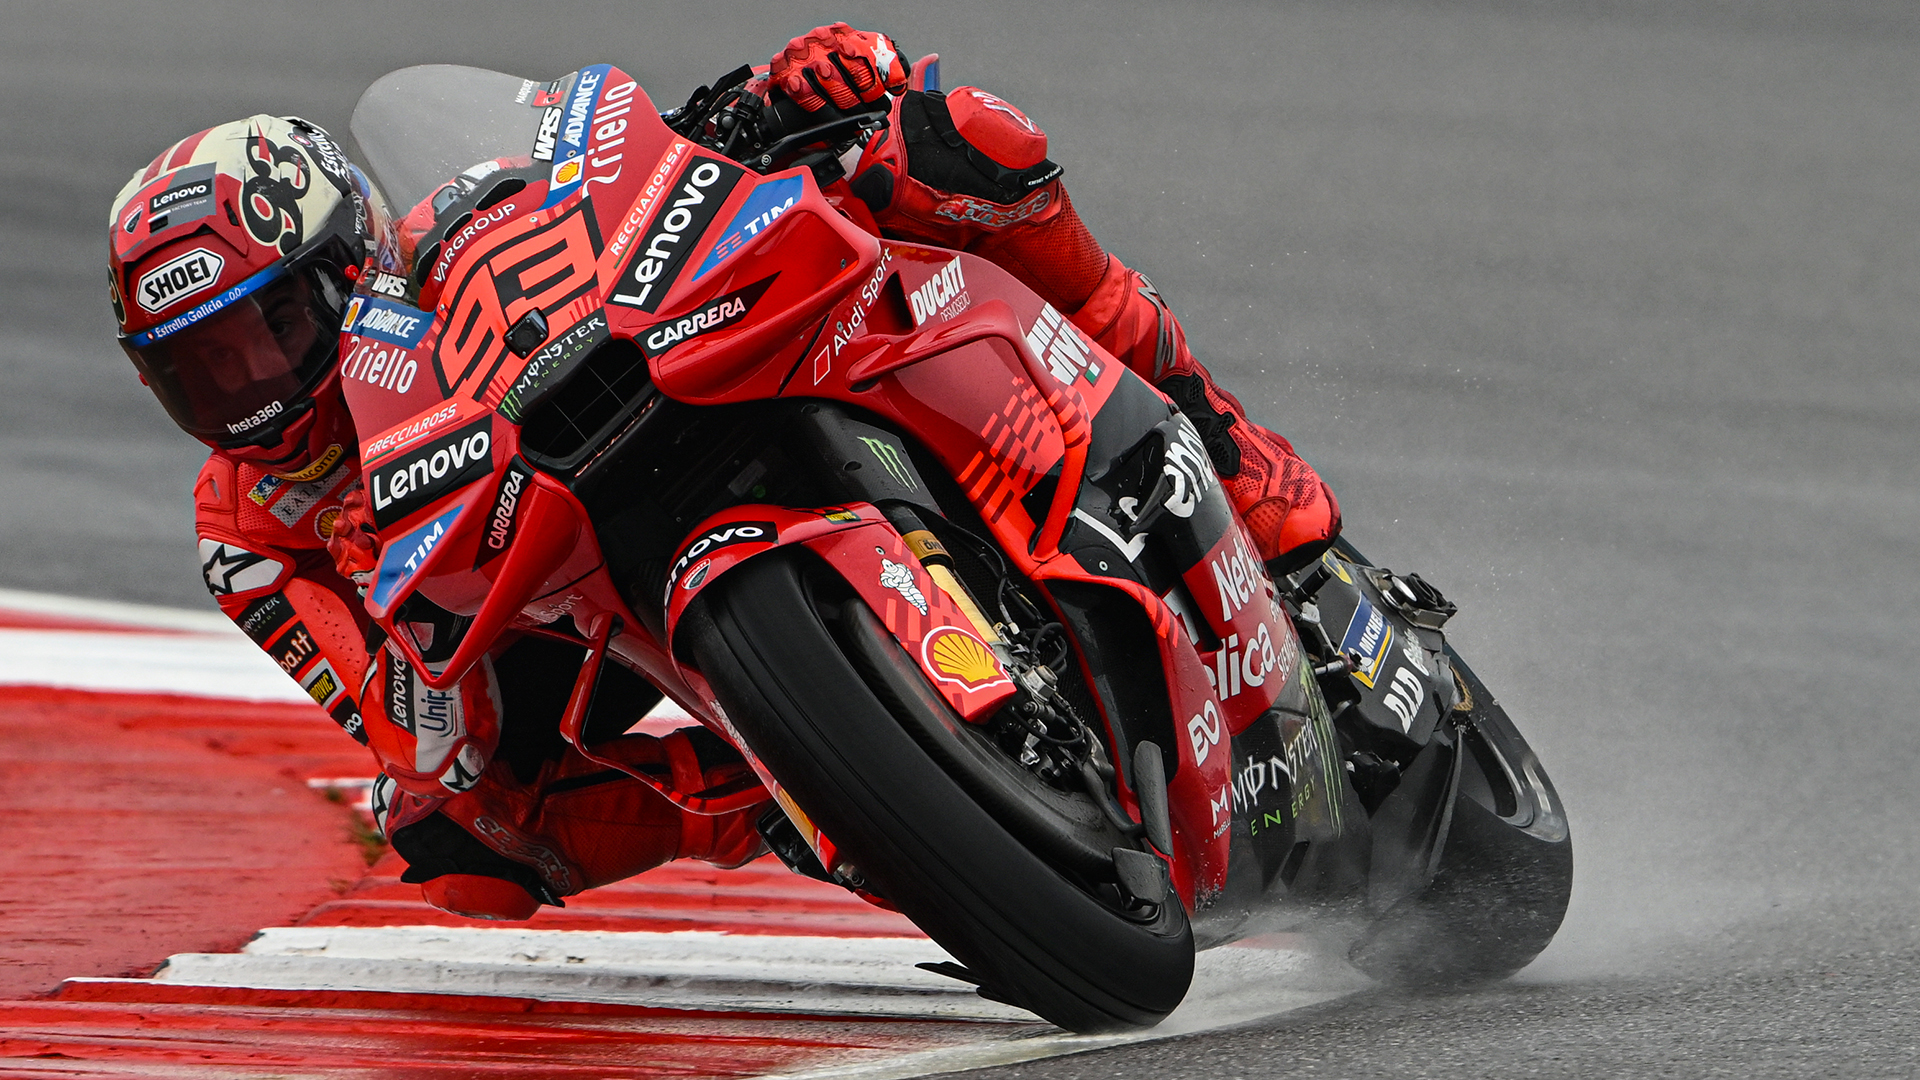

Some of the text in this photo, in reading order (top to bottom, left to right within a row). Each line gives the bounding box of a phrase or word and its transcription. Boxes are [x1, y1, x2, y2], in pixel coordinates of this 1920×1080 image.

[566, 73, 601, 148] ADVANCE
[153, 185, 207, 208] Lenovo
[610, 143, 686, 256] RECCIAROSSA
[744, 196, 794, 236] TIM
[434, 203, 516, 282] VARGROUP
[613, 162, 720, 306] Lenovo
[144, 256, 211, 305] SHOEI
[438, 209, 597, 396] 93
[832, 247, 892, 356] Audi Sport
[910, 255, 966, 326] DUCATI
[155, 318, 189, 338] Estrella
[188, 299, 224, 327] Galicia
[358, 307, 420, 338] ADVANCE
[647, 297, 746, 350] CARRERA
[533, 339, 595, 389] ENERGY
[227, 400, 284, 434] Insta360
[365, 403, 458, 458] FRECCIAROSS
[373, 431, 489, 511] Lenovo
[488, 470, 524, 550] CARRERA
[404, 521, 444, 570] TIM
[1250, 777, 1316, 836] ENERGY
